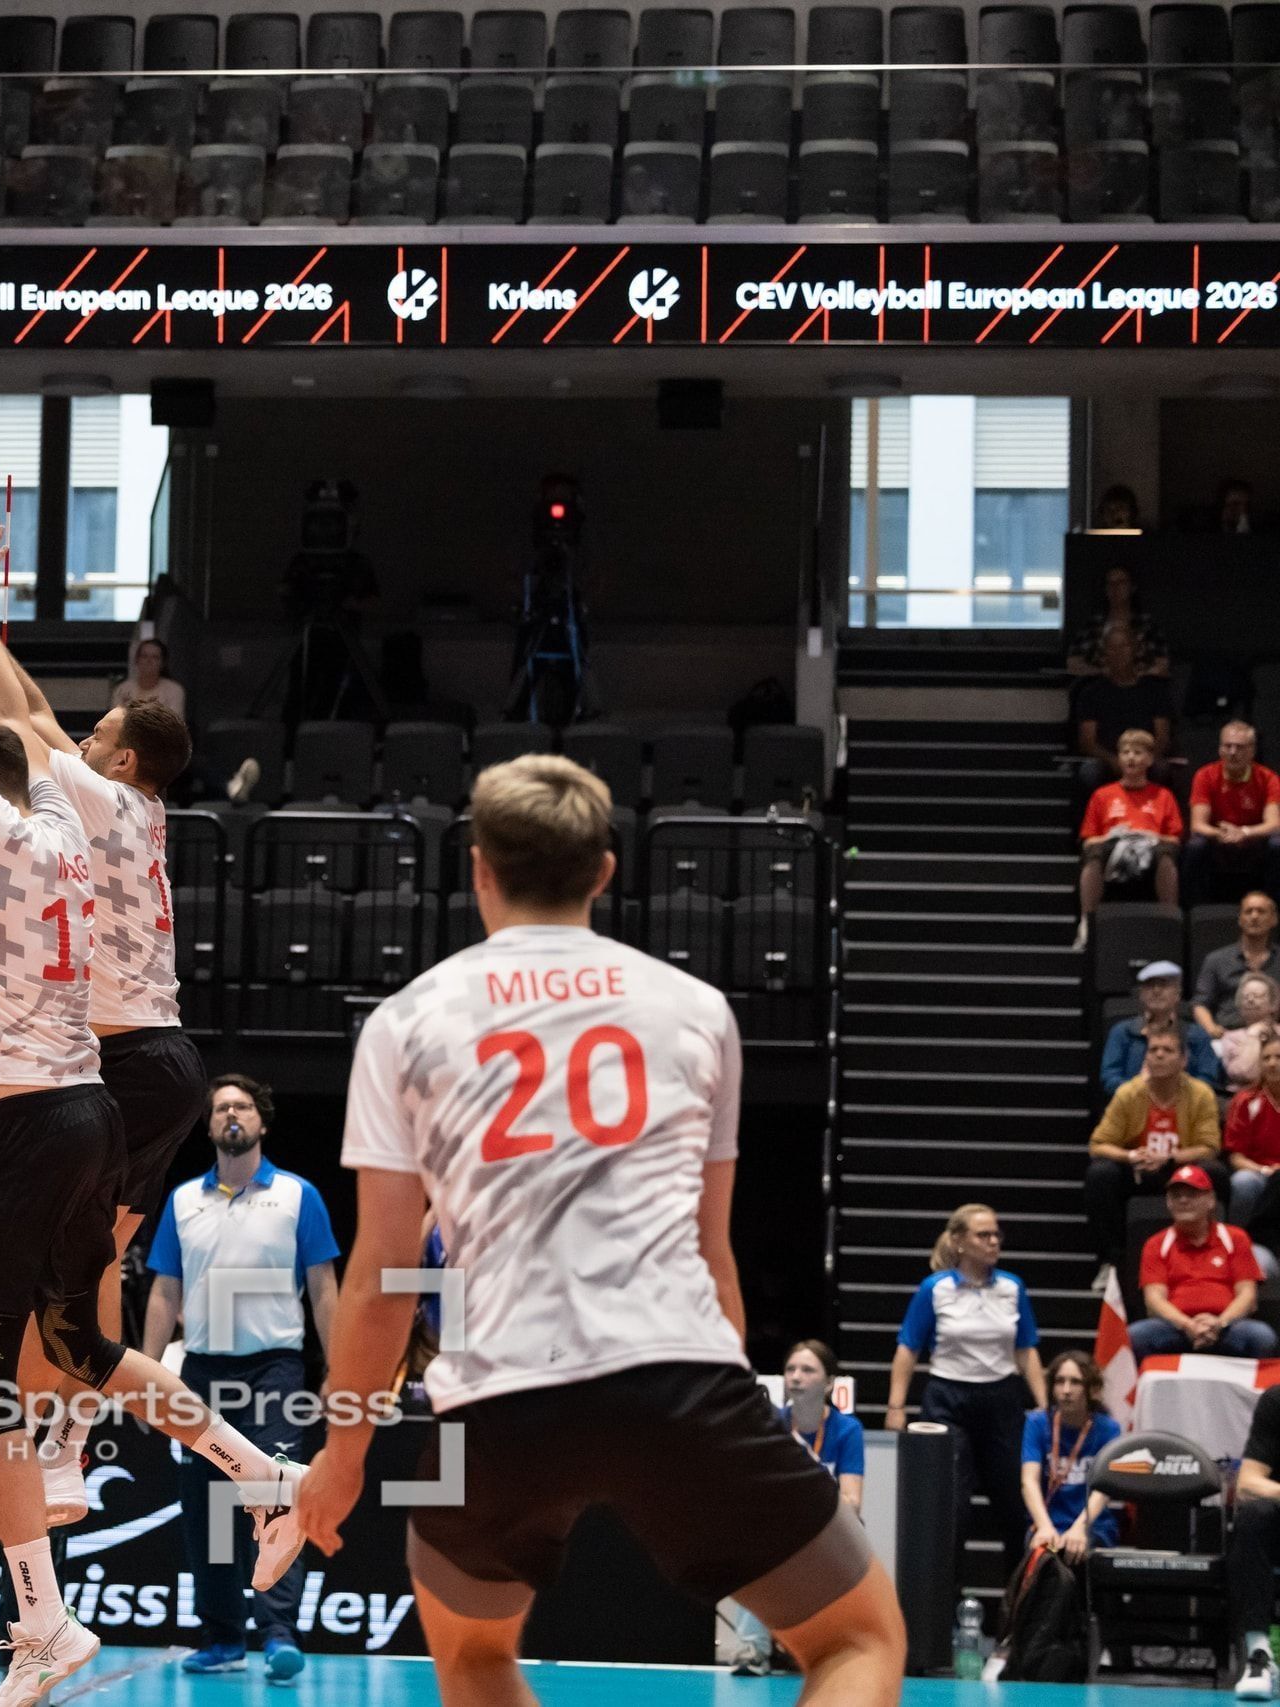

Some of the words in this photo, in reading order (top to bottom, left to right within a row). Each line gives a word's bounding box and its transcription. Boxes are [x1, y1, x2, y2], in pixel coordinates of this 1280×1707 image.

[21, 284, 151, 317] European
[157, 283, 259, 317] League
[264, 284, 333, 311] 2026
[488, 281, 577, 311] Kriens
[736, 282, 798, 310] CEV
[801, 280, 942, 315] Volleyball
[948, 281, 1085, 316] European
[1092, 281, 1200, 316] League
[1205, 281, 1278, 310] 2026
[486, 966, 626, 1005] MIGGE
[476, 1022, 649, 1163] 20
[209, 1443, 234, 1464] CRAFT
[18, 1560, 35, 1593] CRAFT
